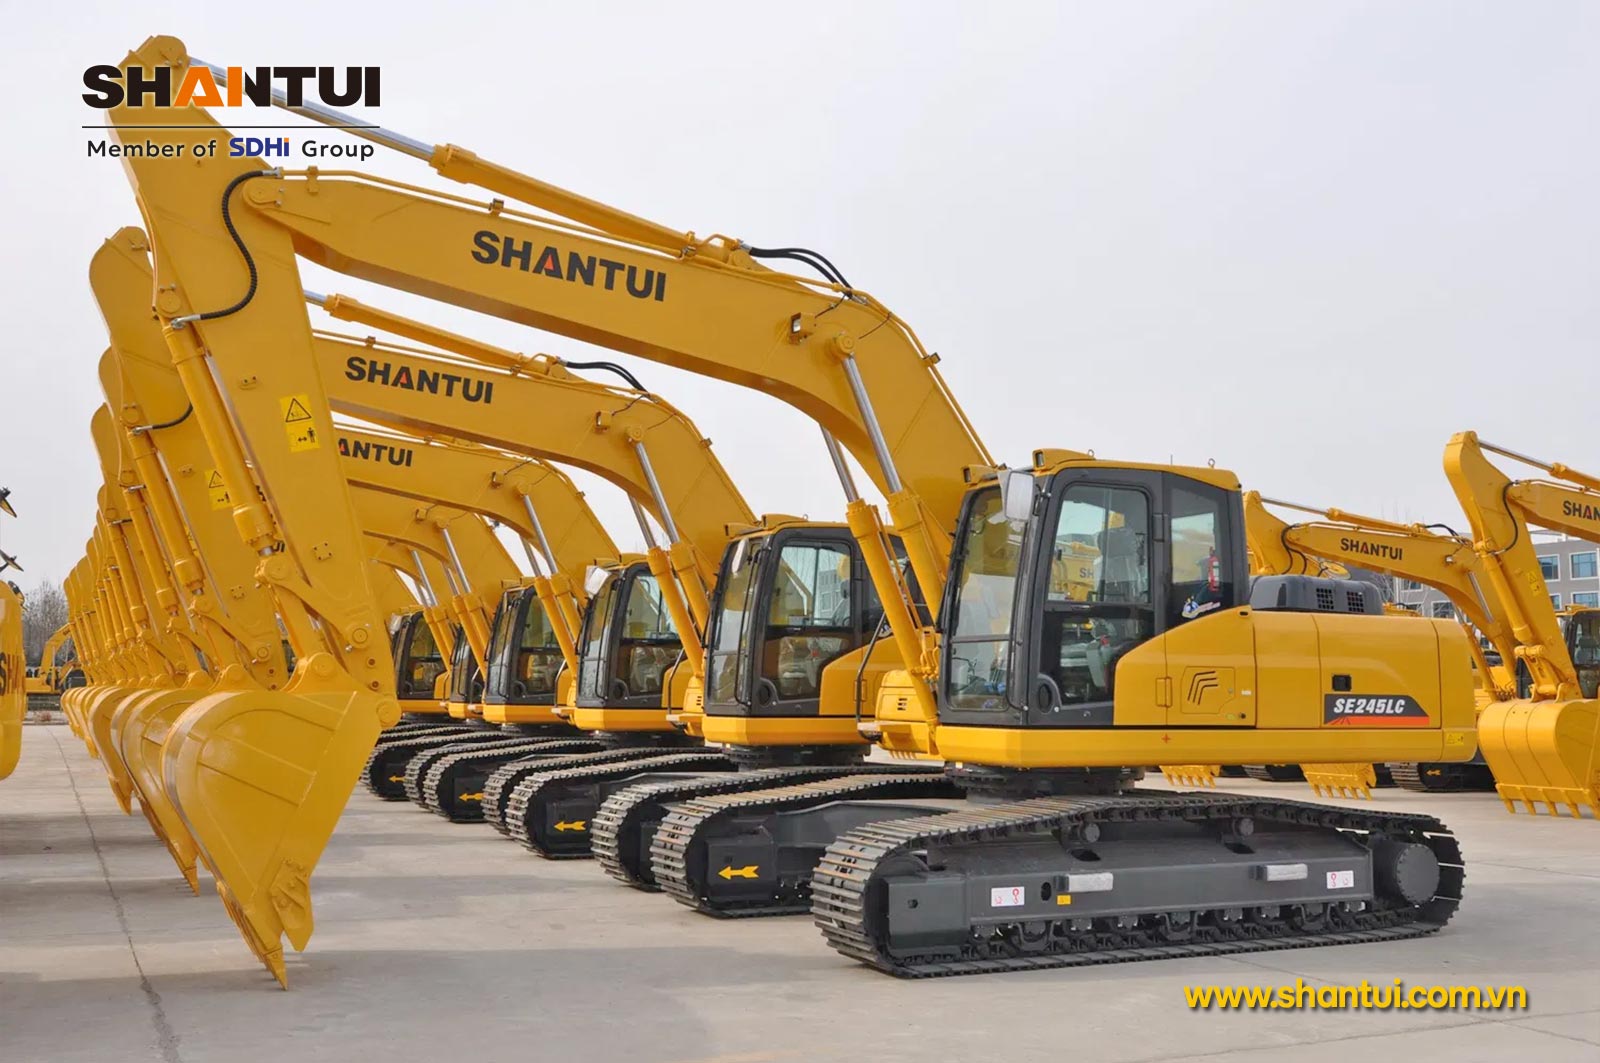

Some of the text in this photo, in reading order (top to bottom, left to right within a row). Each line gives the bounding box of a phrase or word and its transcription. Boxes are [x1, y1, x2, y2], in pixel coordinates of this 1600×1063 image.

[471, 230, 667, 302] SHANTUI
[345, 356, 494, 404] SHANTUI
[1340, 538, 1403, 561] SHANTUI
[1333, 698, 1406, 714] SE245LC
